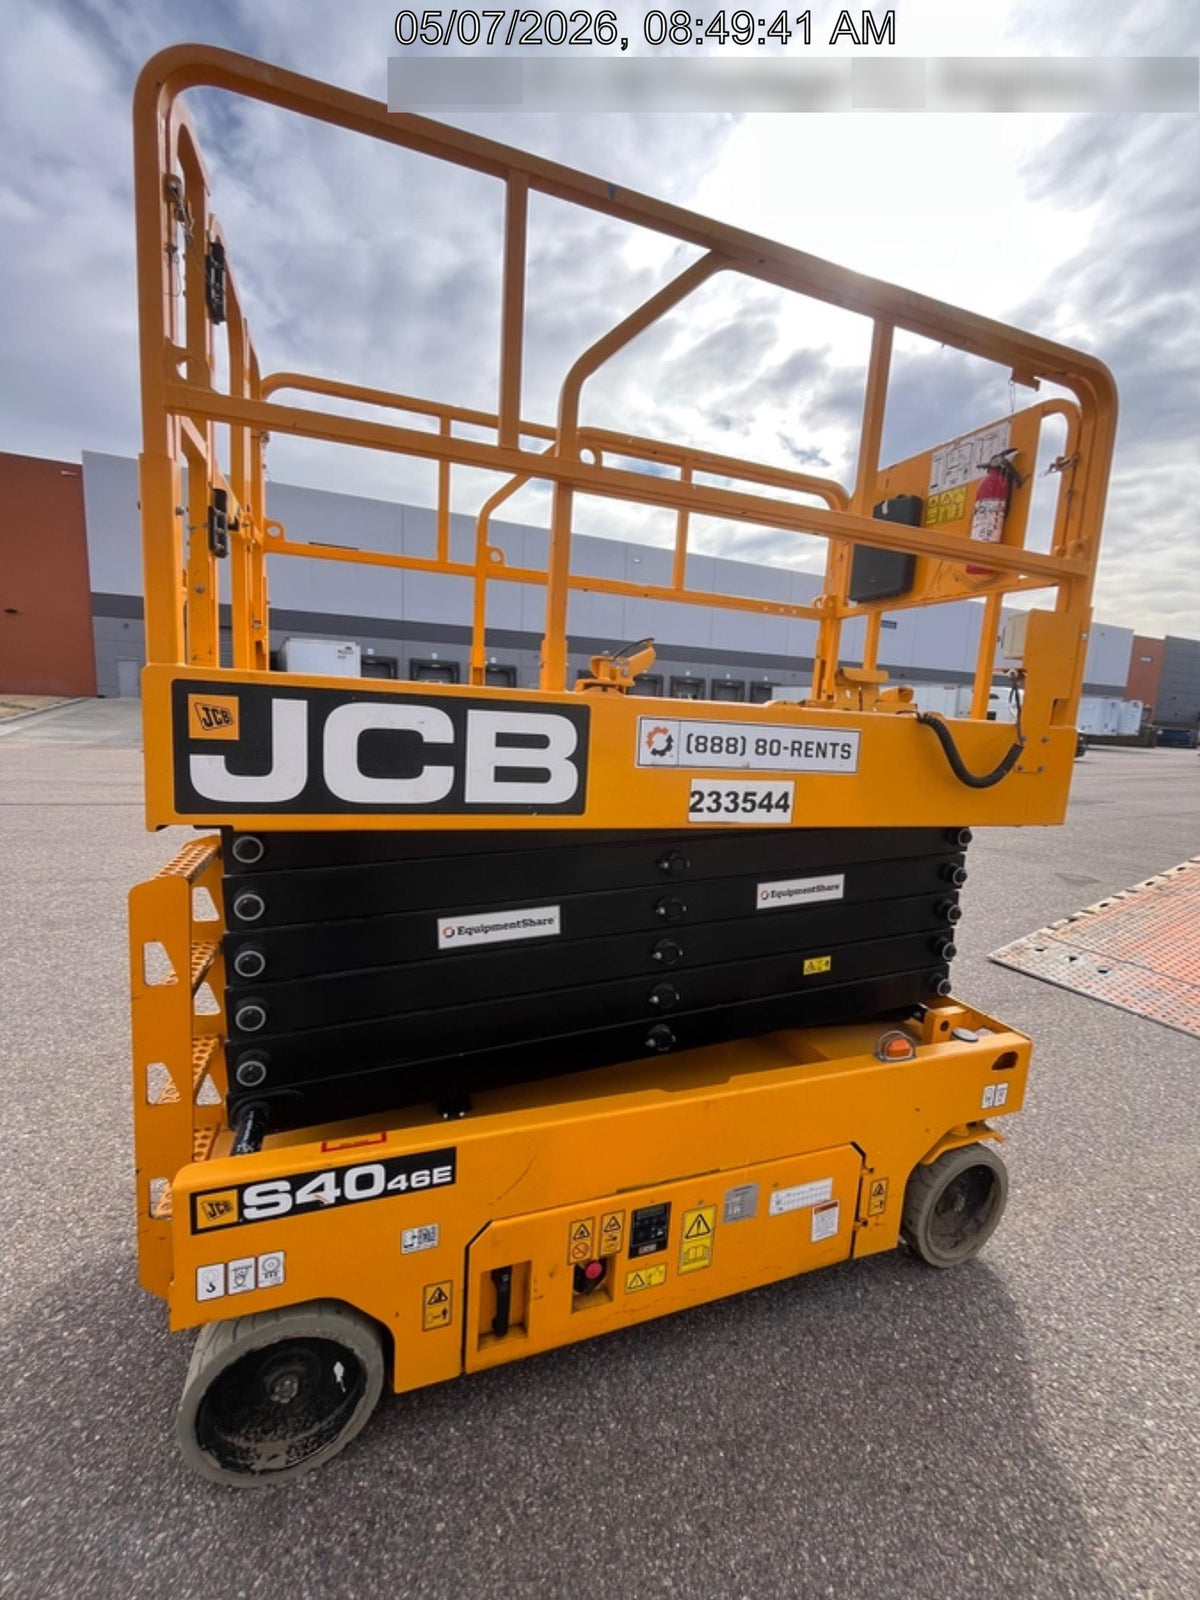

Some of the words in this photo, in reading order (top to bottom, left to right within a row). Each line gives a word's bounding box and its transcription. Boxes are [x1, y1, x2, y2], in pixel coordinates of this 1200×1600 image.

[202, 706, 230, 727] JCB
[189, 698, 579, 804] JCB
[686, 732, 747, 757] (888)
[754, 738, 853, 761] 80-RENTS
[689, 791, 791, 814] 233544
[771, 883, 840, 899] EquipmentShare
[456, 917, 556, 936] EquipmentShare
